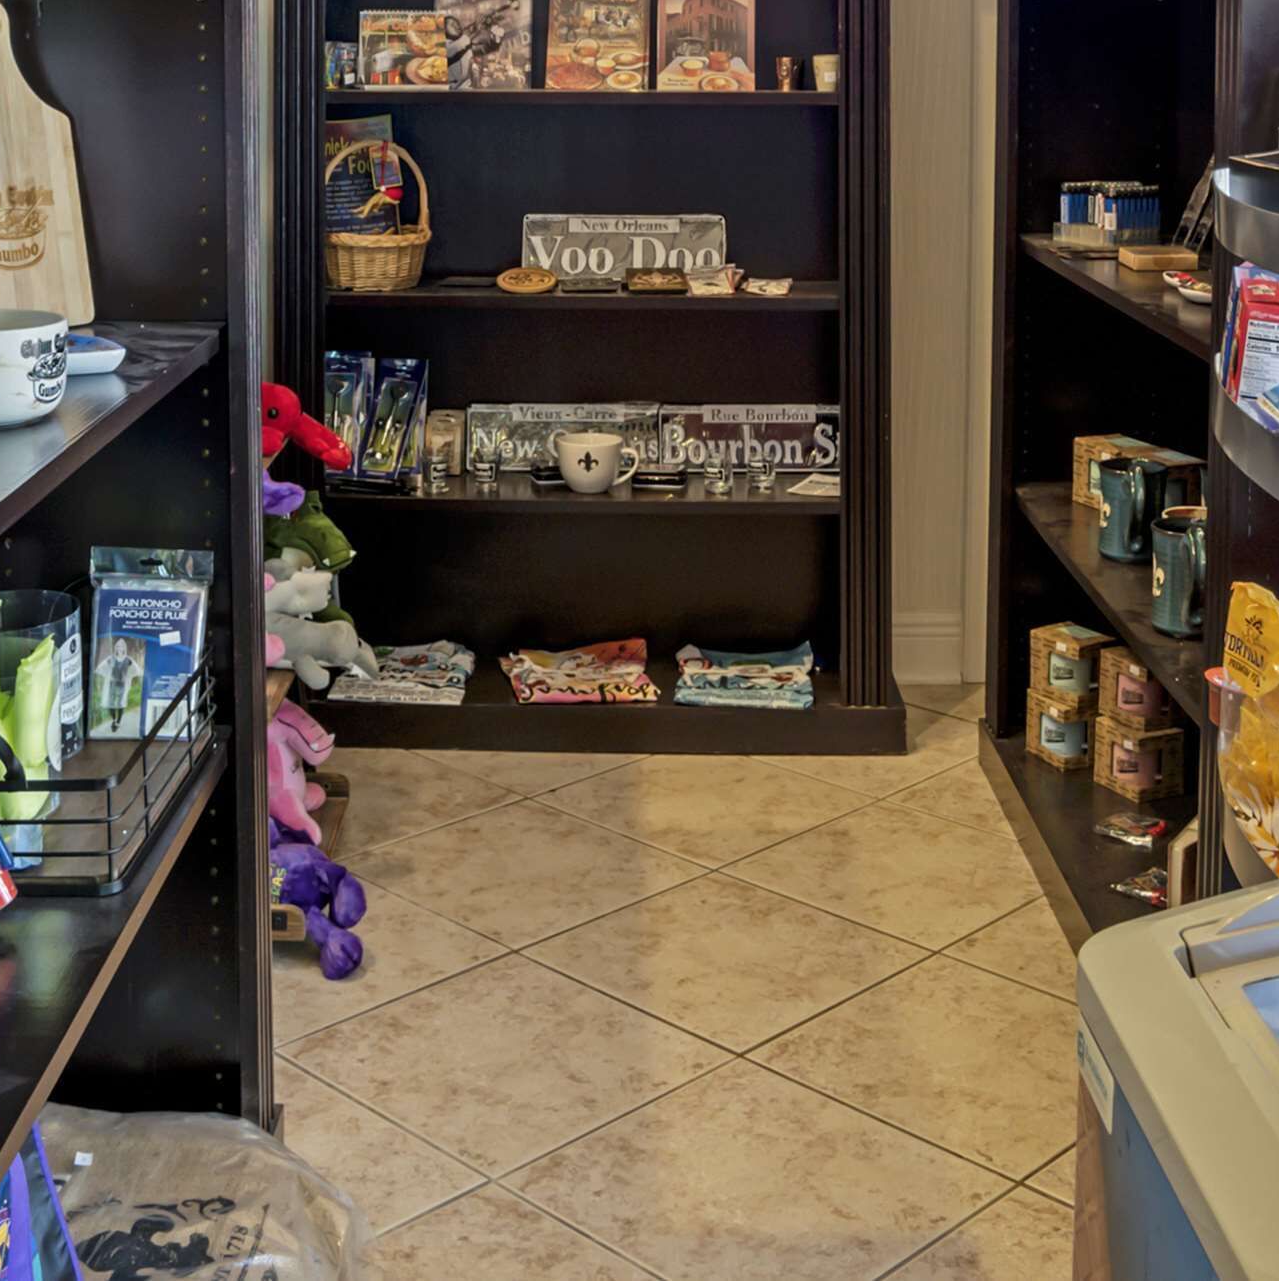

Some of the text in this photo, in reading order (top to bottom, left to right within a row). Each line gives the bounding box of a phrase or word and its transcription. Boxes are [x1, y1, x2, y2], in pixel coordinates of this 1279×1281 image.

[580, 219, 669, 232] New Orleans
[527, 235, 722, 275] Voo Doo
[711, 408, 810, 422] Rue Bourbon
[474, 427, 540, 457] New
[663, 423, 804, 465] Bourbon
[815, 422, 841, 466] S
[117, 597, 182, 609] RAIN PONCHO
[109, 609, 149, 619] PONCHO
[151, 611, 163, 620] DE
